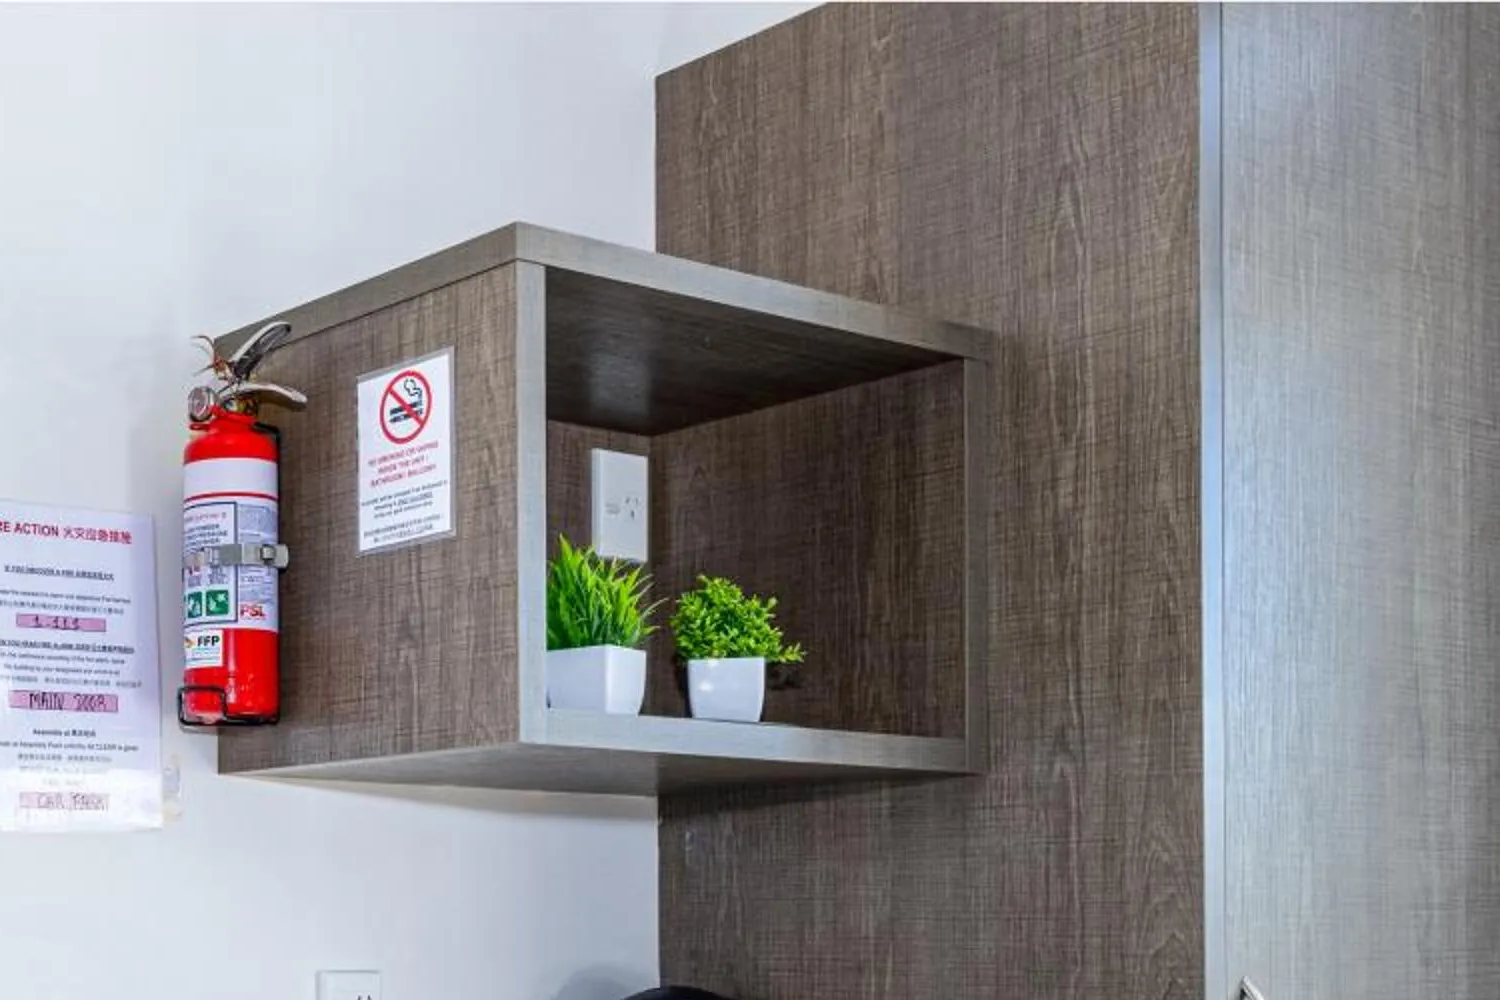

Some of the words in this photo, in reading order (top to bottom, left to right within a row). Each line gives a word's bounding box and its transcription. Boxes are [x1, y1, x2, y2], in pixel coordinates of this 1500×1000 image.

[14, 522, 59, 537] ACTION
[197, 635, 221, 647] FFP
[29, 692, 64, 711] MAIN
